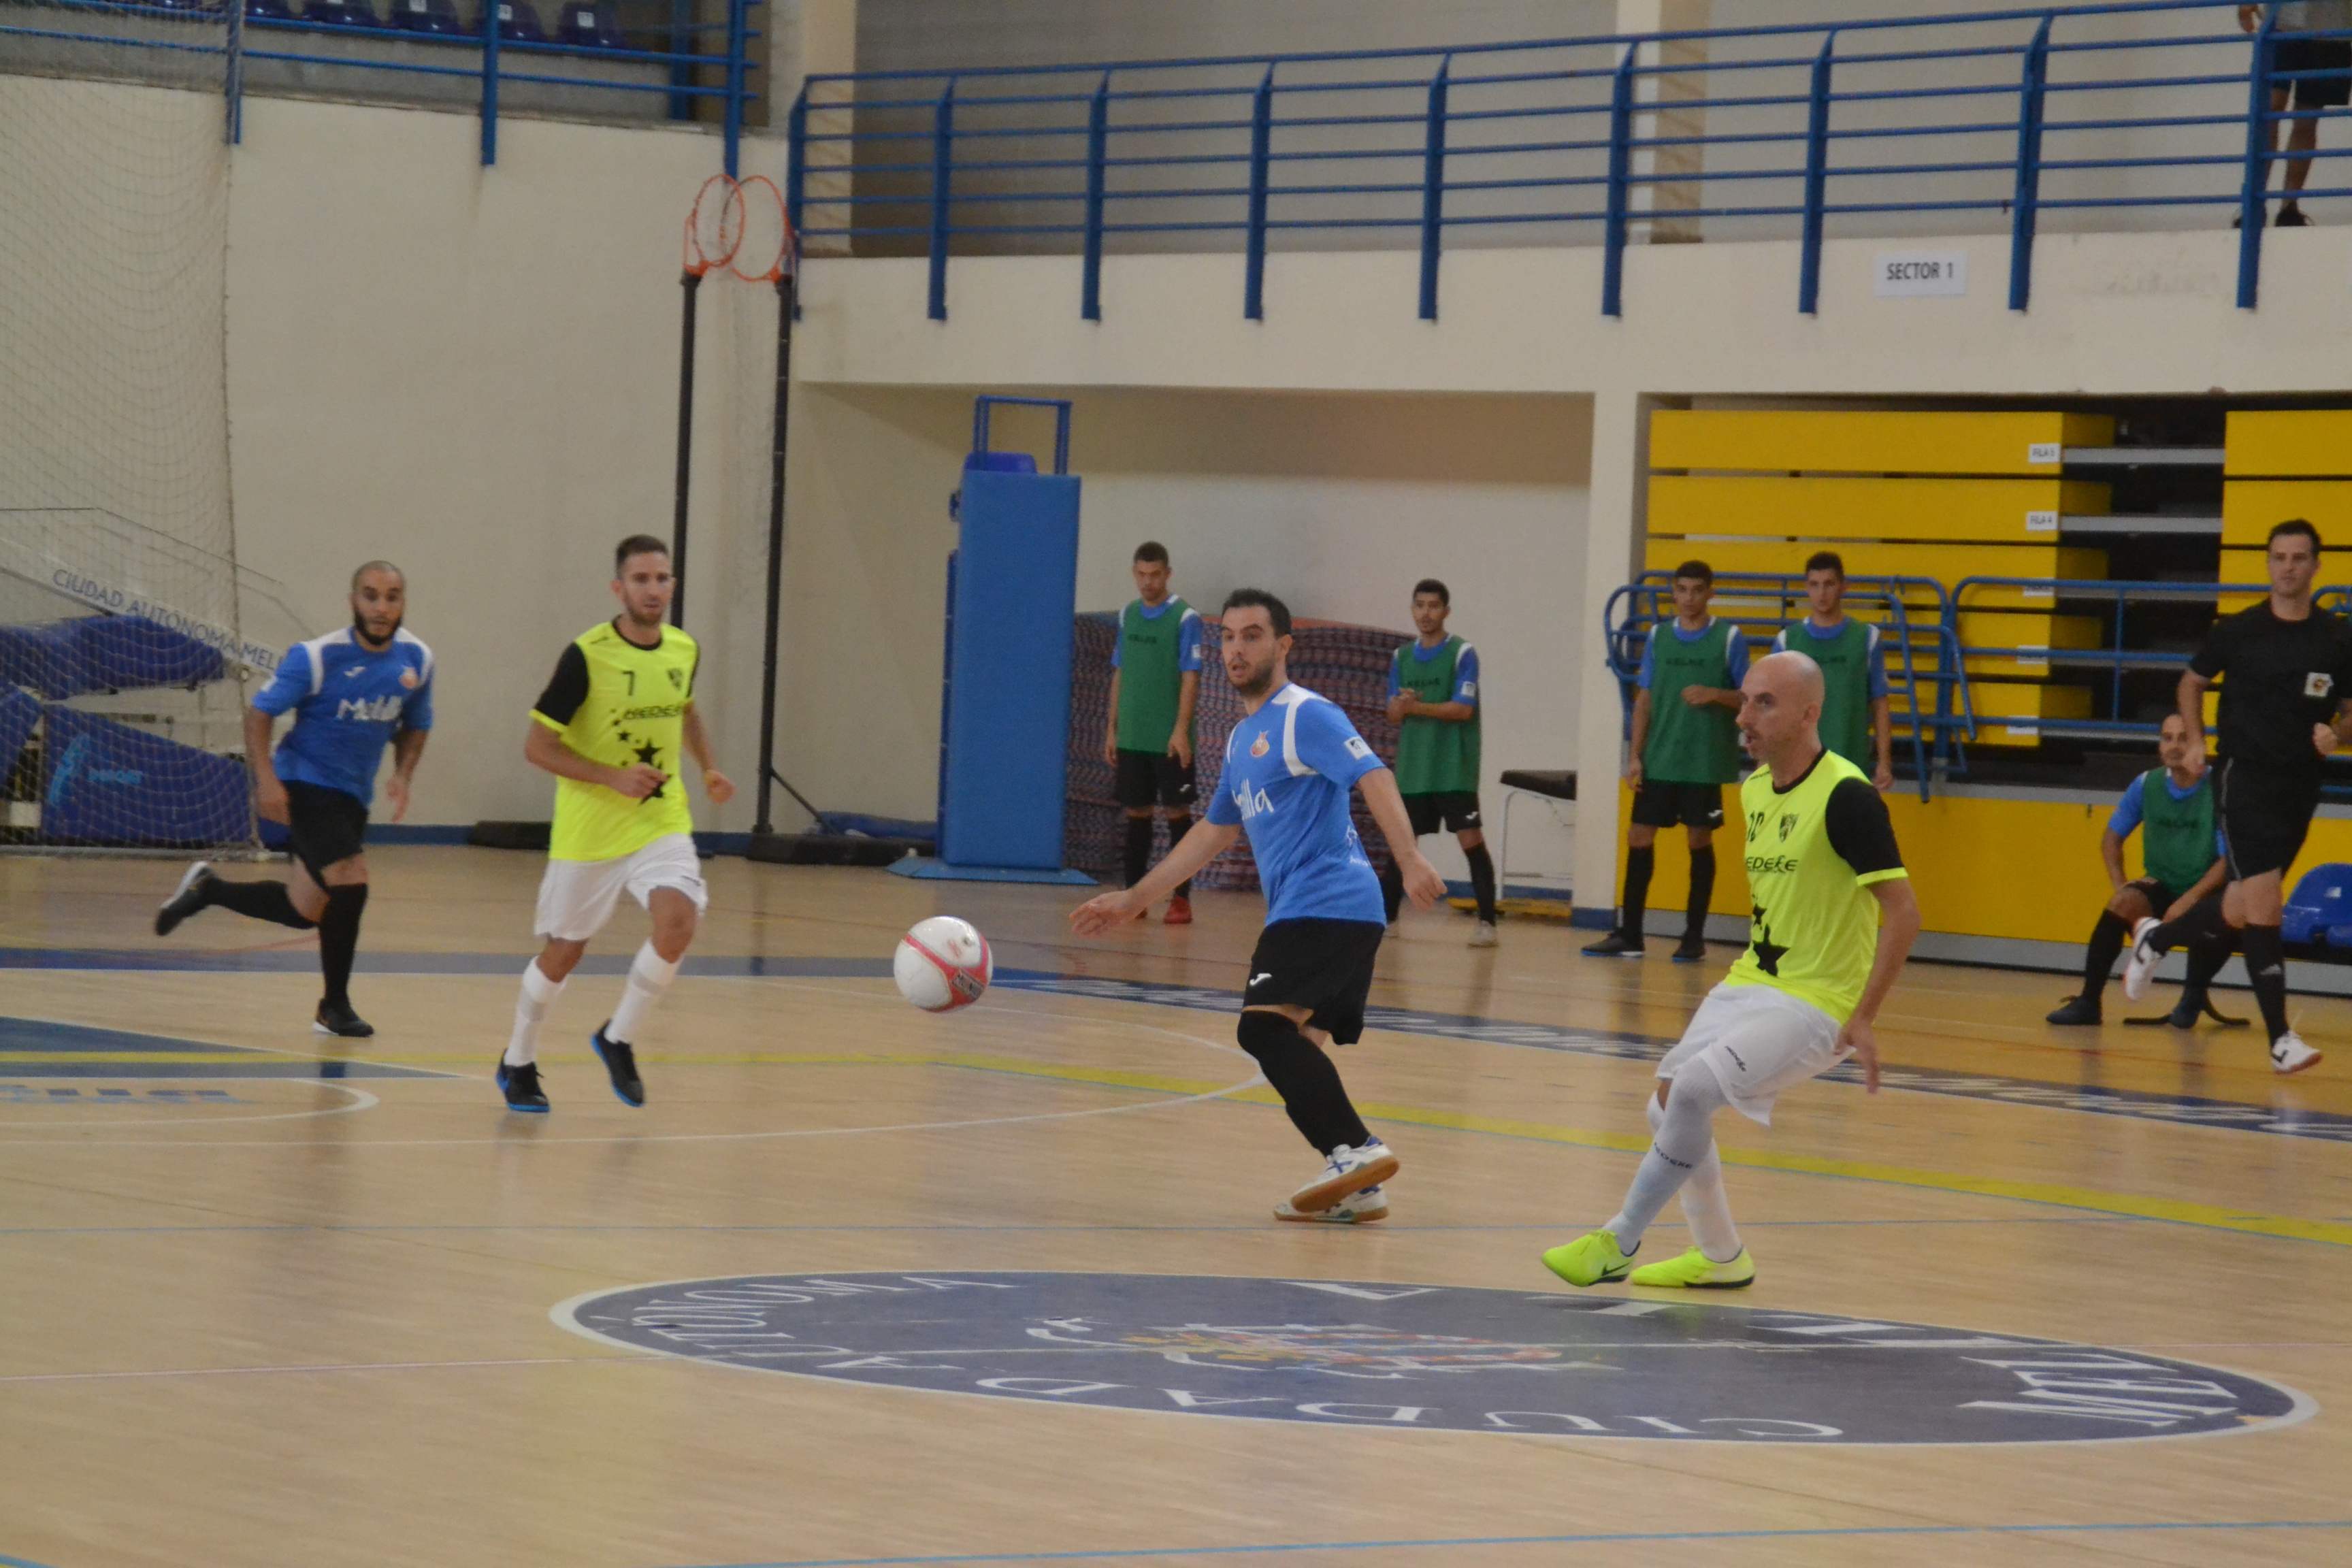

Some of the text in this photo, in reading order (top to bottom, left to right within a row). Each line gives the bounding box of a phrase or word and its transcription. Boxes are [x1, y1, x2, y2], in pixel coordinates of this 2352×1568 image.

[1887, 262, 1953, 280] SECTOR 1
[53, 569, 125, 607] CIUDAD
[622, 670, 635, 696] 7
[976, 1376, 1844, 1437] CIUDAD
